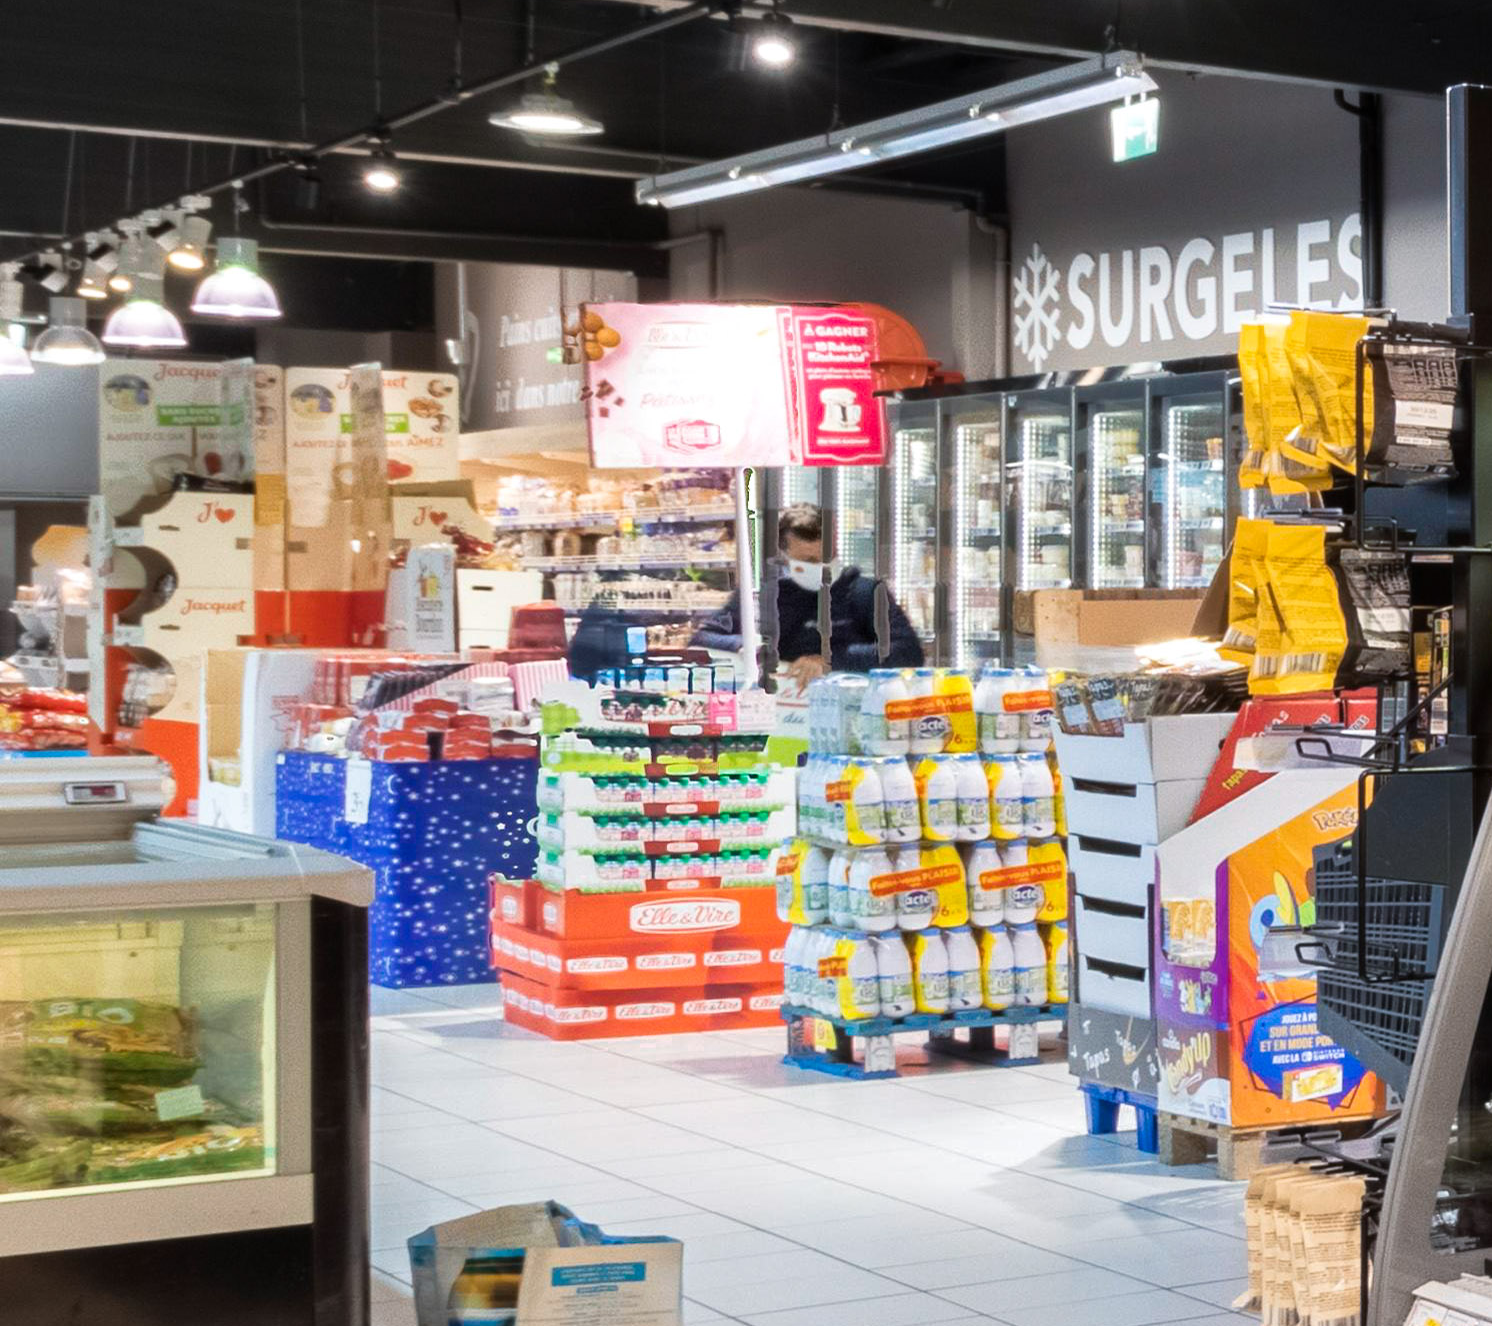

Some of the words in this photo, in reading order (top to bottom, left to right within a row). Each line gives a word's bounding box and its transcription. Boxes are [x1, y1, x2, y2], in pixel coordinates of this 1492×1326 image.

[1066, 212, 1363, 350] SURGELES
[814, 327, 868, 337] GAGNER
[181, 598, 247, 616] Jacquet
